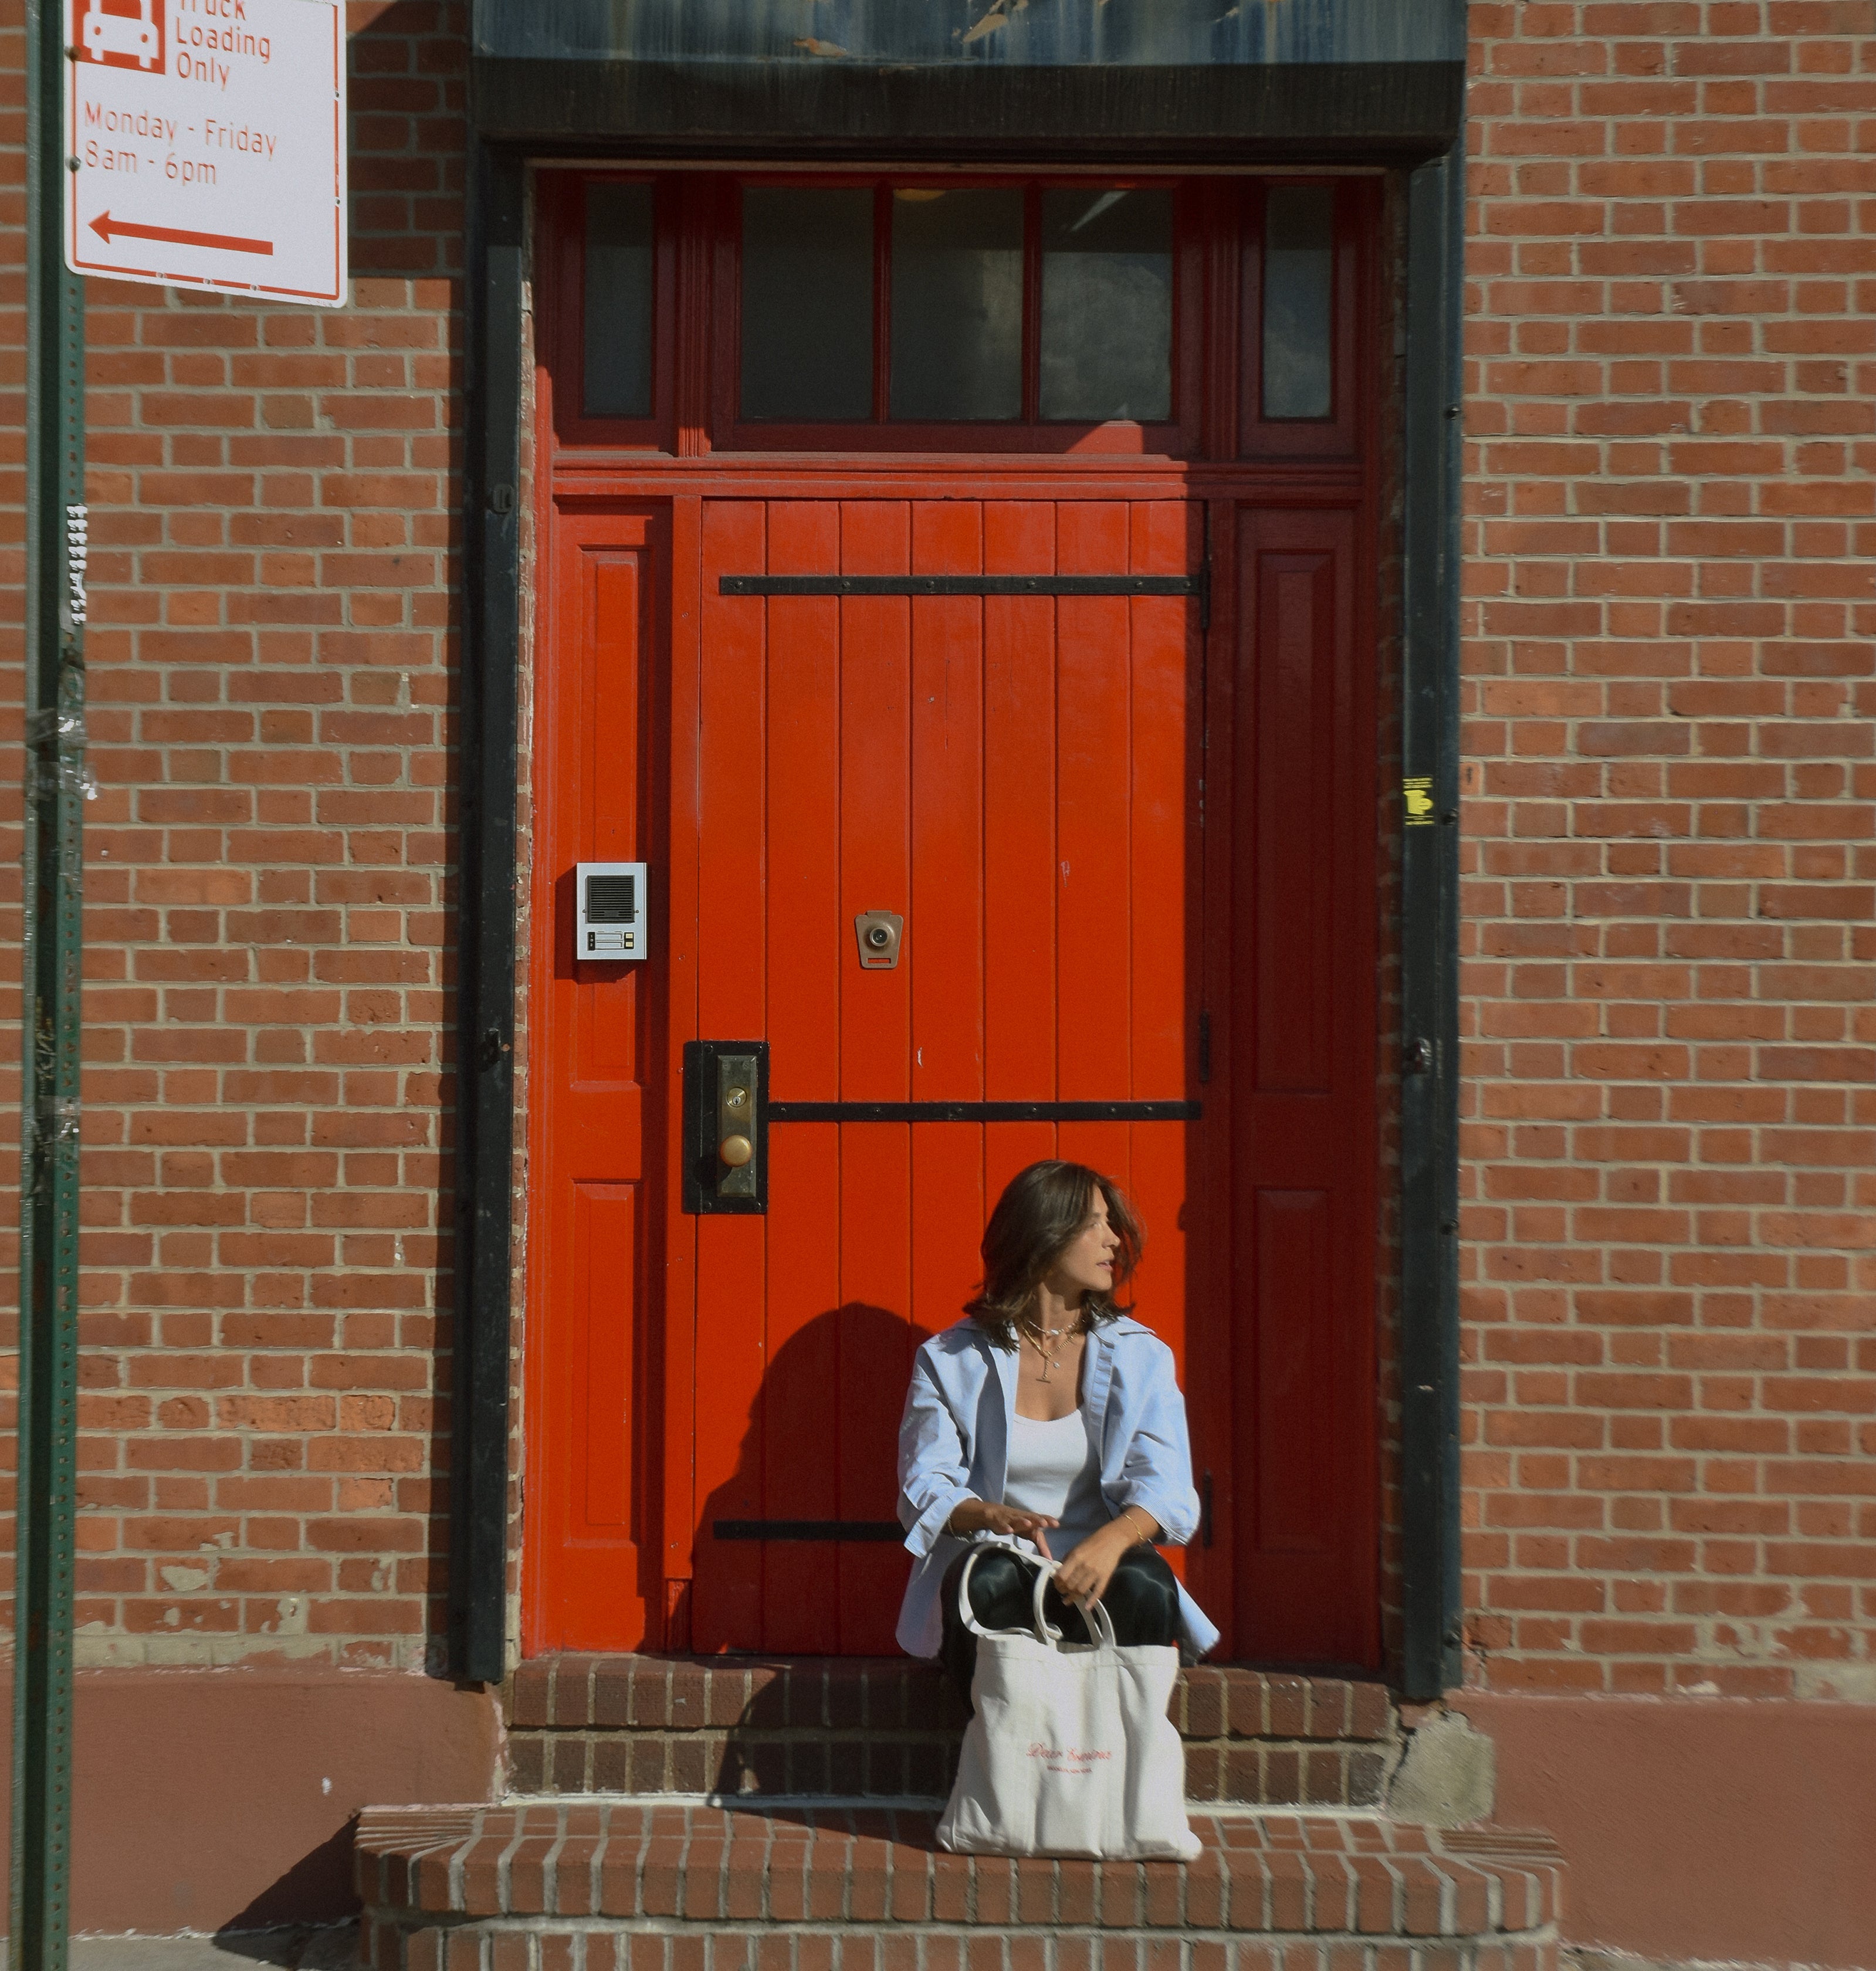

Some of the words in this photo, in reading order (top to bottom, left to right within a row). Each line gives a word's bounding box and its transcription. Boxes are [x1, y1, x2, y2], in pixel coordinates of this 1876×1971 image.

[176, 16, 270, 64] Loading
[177, 51, 229, 91] Only
[85, 101, 176, 146] Monday
[205, 118, 276, 161] Friday
[85, 140, 137, 173] 8am
[165, 153, 216, 185] 6pm
